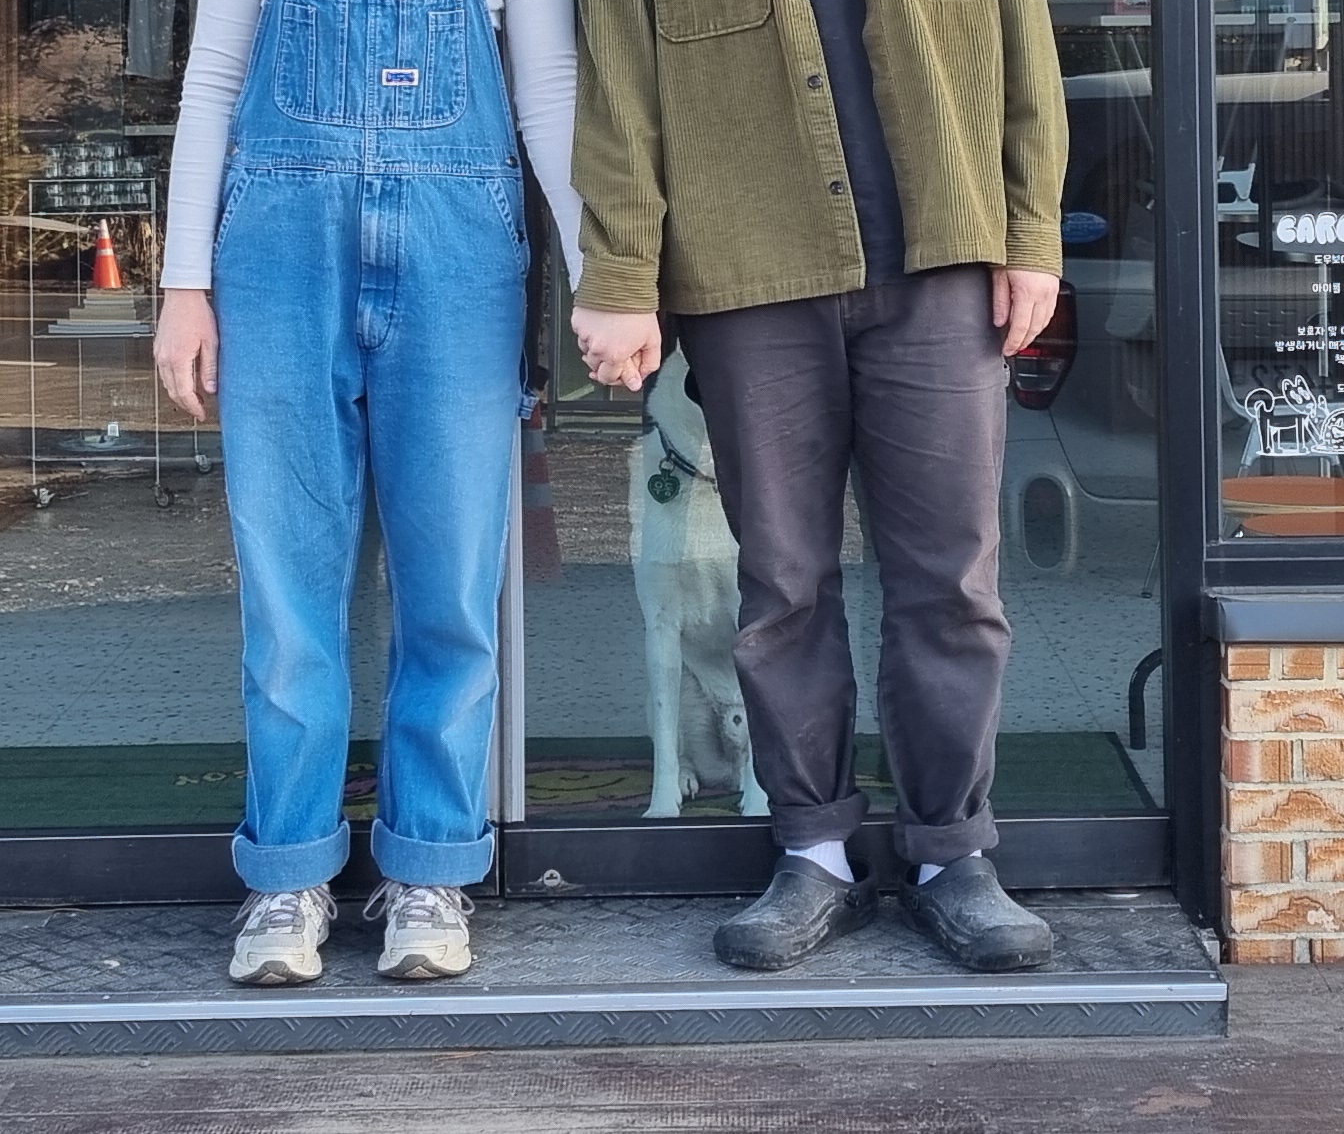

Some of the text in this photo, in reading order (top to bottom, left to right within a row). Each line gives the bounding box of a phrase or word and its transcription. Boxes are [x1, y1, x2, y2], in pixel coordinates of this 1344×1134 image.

[1312, 282, 1341, 294] 아이를
[1297, 325, 1325, 336] 보호자
[1327, 325, 1337, 337] 및
[1274, 340, 1326, 352] 발생하거나
